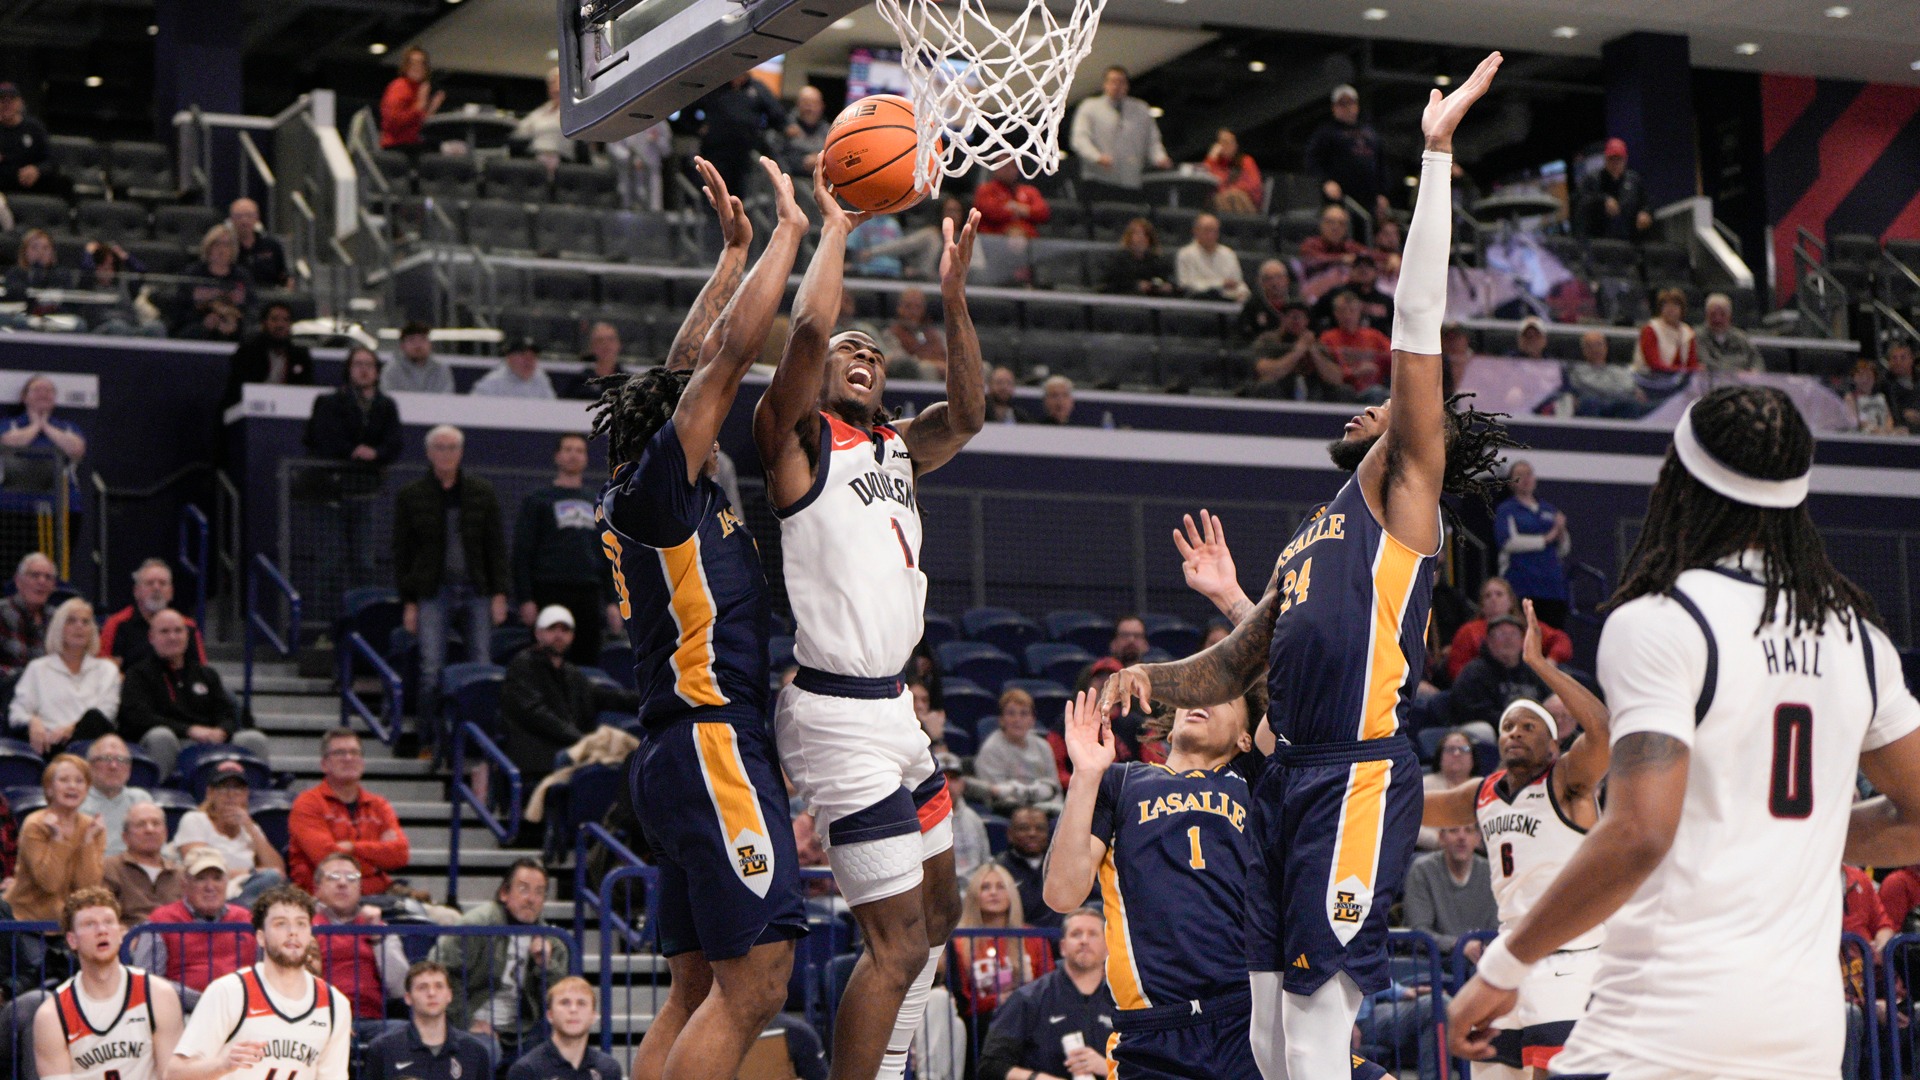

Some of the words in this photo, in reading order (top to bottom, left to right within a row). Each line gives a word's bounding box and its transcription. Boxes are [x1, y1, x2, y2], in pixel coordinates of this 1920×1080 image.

[848, 472, 914, 514] DUQUESN
[890, 517, 914, 568] 1
[1279, 556, 1312, 615] 24
[1762, 637, 1822, 678] HALL
[1768, 702, 1813, 820] 0
[1187, 826, 1206, 870] 1
[1483, 813, 1541, 842] DUQUESNE
[1501, 842, 1514, 877] 6
